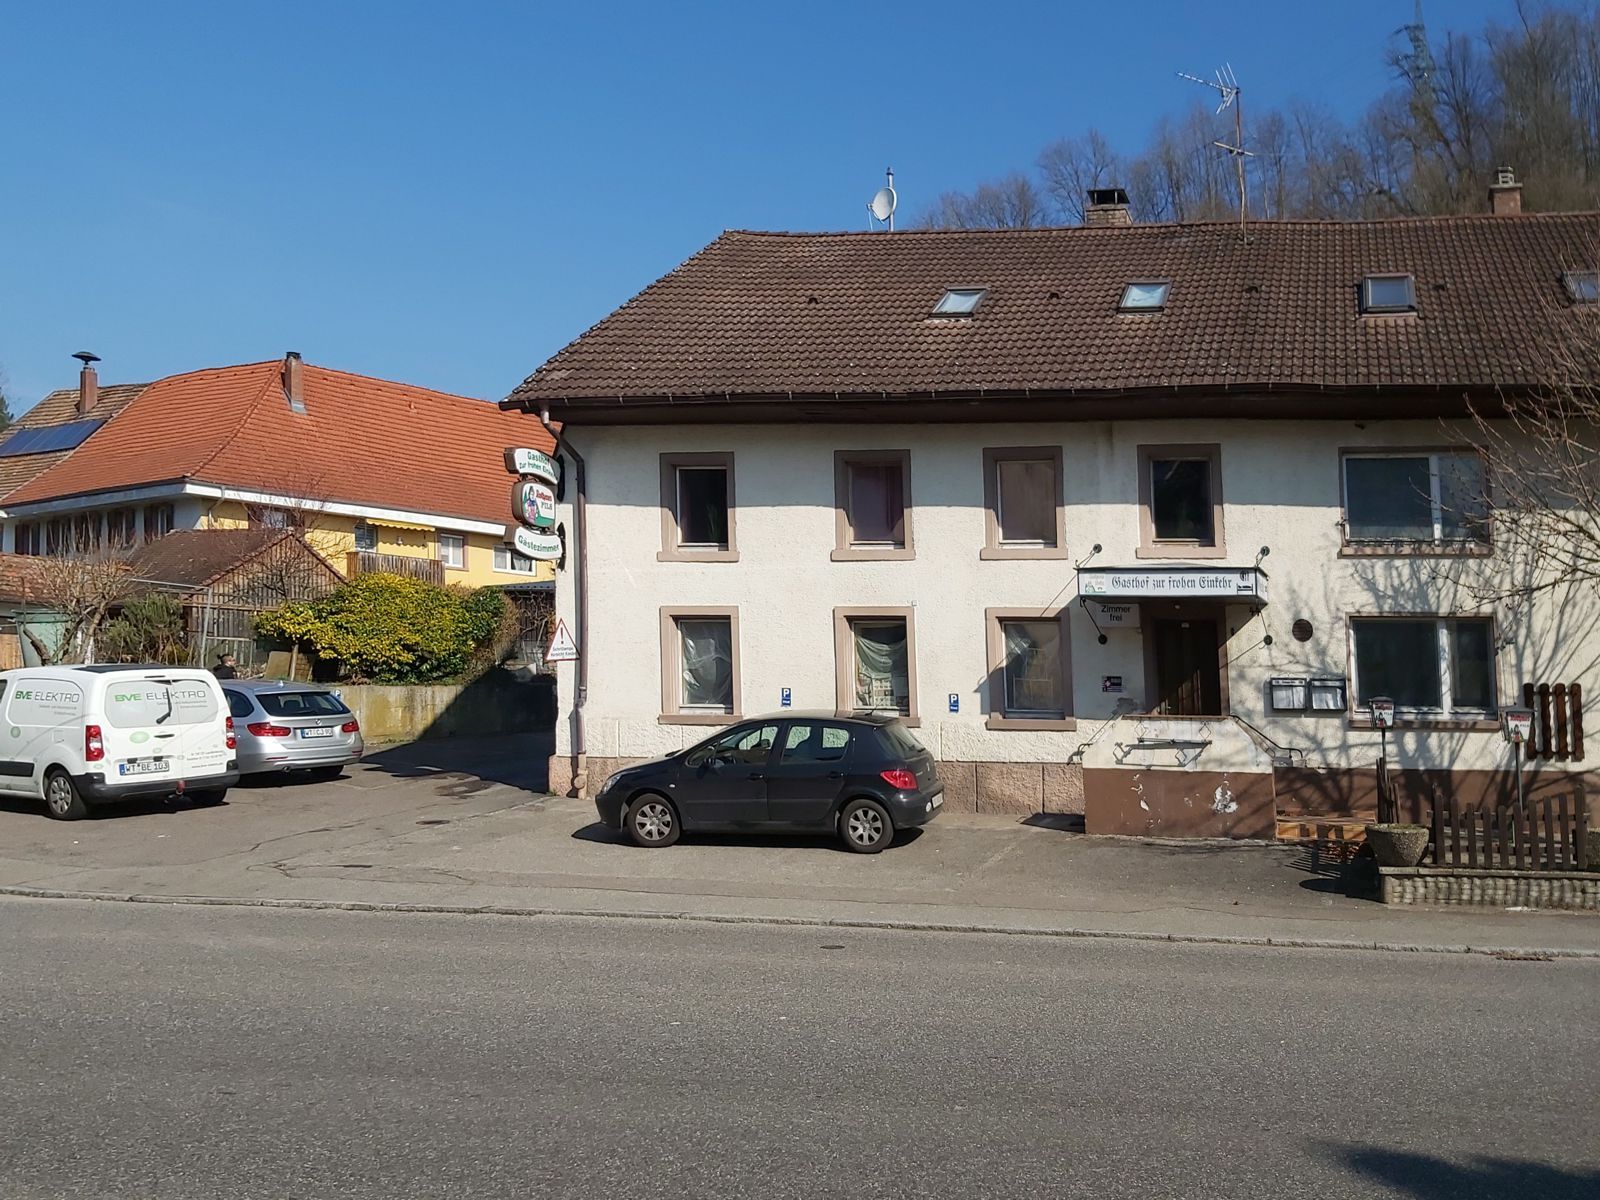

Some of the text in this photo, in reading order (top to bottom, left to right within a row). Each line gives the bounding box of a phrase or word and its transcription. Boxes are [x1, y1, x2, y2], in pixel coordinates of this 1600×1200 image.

[518, 535, 559, 552] Gästezimmer
[1112, 575, 1232, 590] Gasthof zur frohen Einkehr
[1101, 605, 1131, 613] Zimmer
[1109, 613, 1122, 621] frei
[15, 691, 79, 703] BVE ELEKTRO
[114, 690, 206, 702] BVE ELEKTRO
[783, 688, 790, 697] P
[950, 694, 958, 703] P
